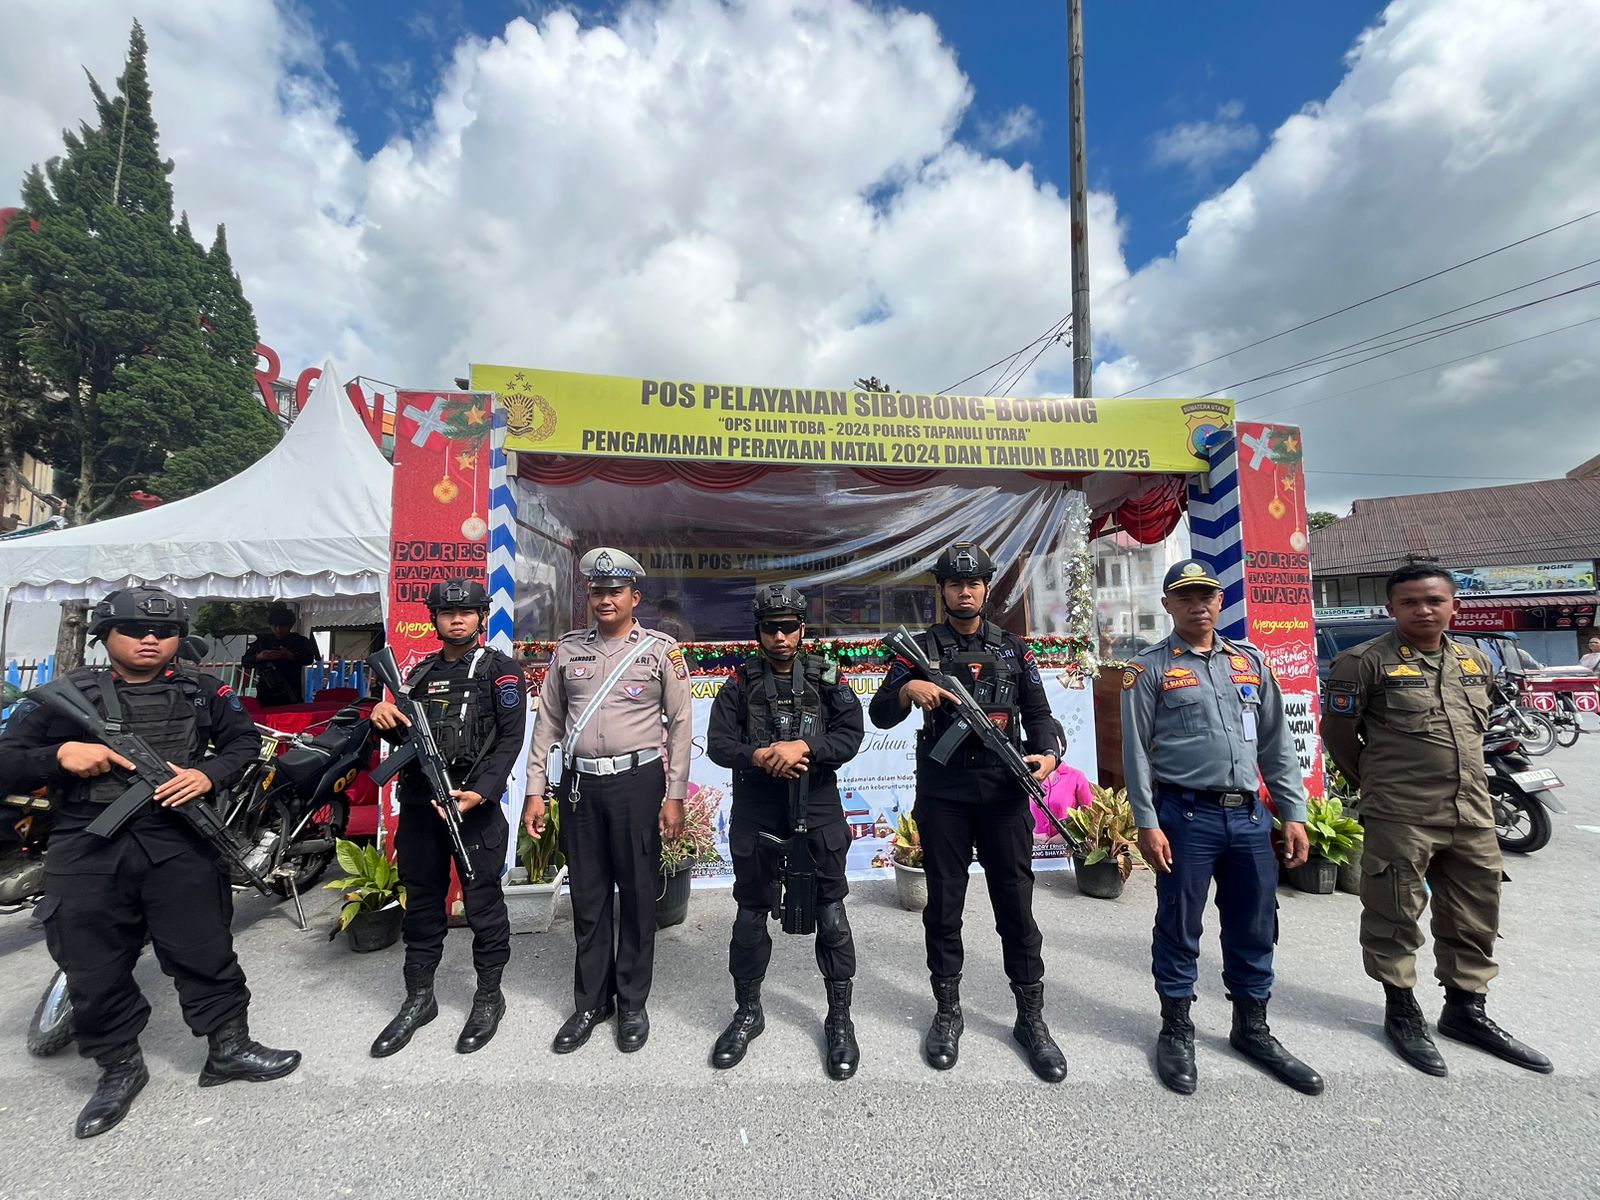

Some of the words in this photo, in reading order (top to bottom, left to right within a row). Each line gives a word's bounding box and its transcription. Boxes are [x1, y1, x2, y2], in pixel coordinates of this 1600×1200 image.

[641, 380, 696, 408] POS
[703, 385, 848, 416] PELAYANAN
[854, 392, 1098, 423] SIBORONG-BORONG
[755, 419, 787, 433] LILIN
[790, 420, 826, 435] TOBA
[836, 422, 870, 436] 2024
[873, 424, 920, 438] POLRES
[923, 425, 983, 440] TAPANULI
[582, 429, 722, 456] PENGAMANAN
[728, 437, 826, 460] PERAYAAN
[831, 441, 887, 462] NATAL
[892, 443, 941, 464] 2024
[944, 445, 983, 465] DAN
[986, 446, 1046, 466] TAHUN
[1050, 447, 1100, 467] BARU
[1103, 448, 1151, 468] 2025
[395, 542, 486, 561] POLRES
[1246, 551, 1309, 569] POLRES
[650, 552, 695, 570] DATA
[698, 553, 731, 571] POS
[1537, 563, 1574, 571] ENGINE
[396, 566, 486, 579] TAPANULI
[1249, 572, 1309, 585] TAPANULI
[1251, 587, 1310, 605] UTARA
[1454, 619, 1504, 627] MOTOR
[1455, 612, 1497, 620] SEHAT
[395, 620, 437, 639] Mengu
[1252, 617, 1309, 634] Mengucapkan
[858, 731, 908, 754] Tahun
[897, 774, 914, 782] hidup
